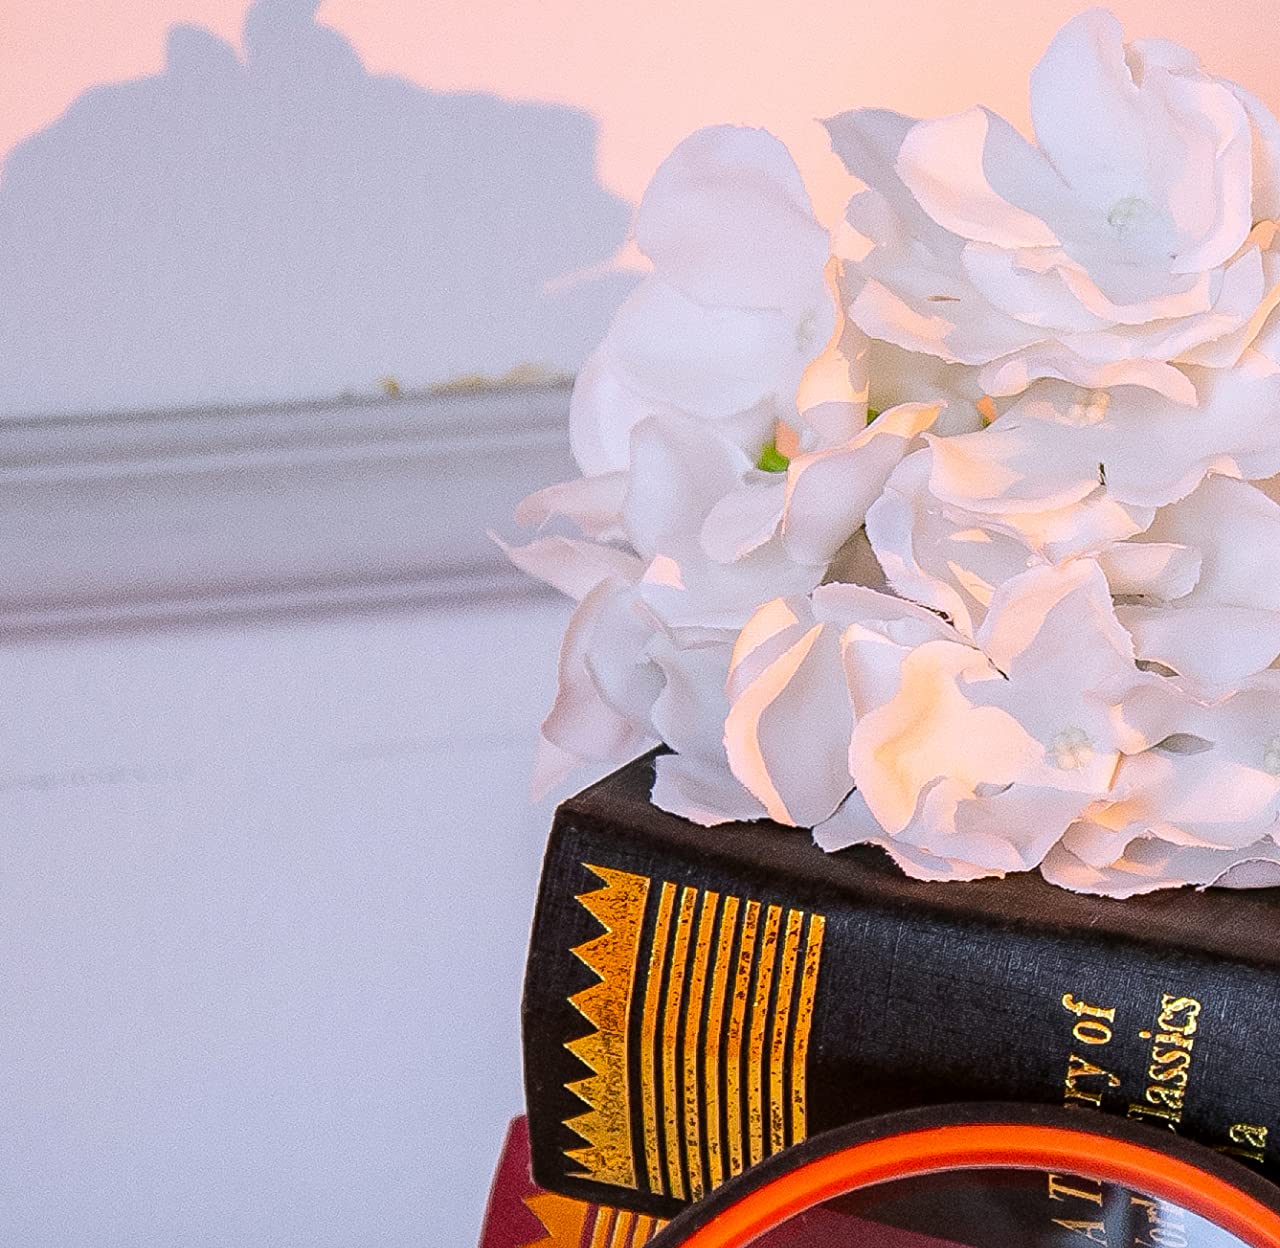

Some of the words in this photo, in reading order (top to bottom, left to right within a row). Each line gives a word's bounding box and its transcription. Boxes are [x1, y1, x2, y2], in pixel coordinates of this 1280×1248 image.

[1061, 993, 1116, 1045] of
[1128, 993, 1201, 1136] lassics
[1051, 1218, 1109, 1248] A
